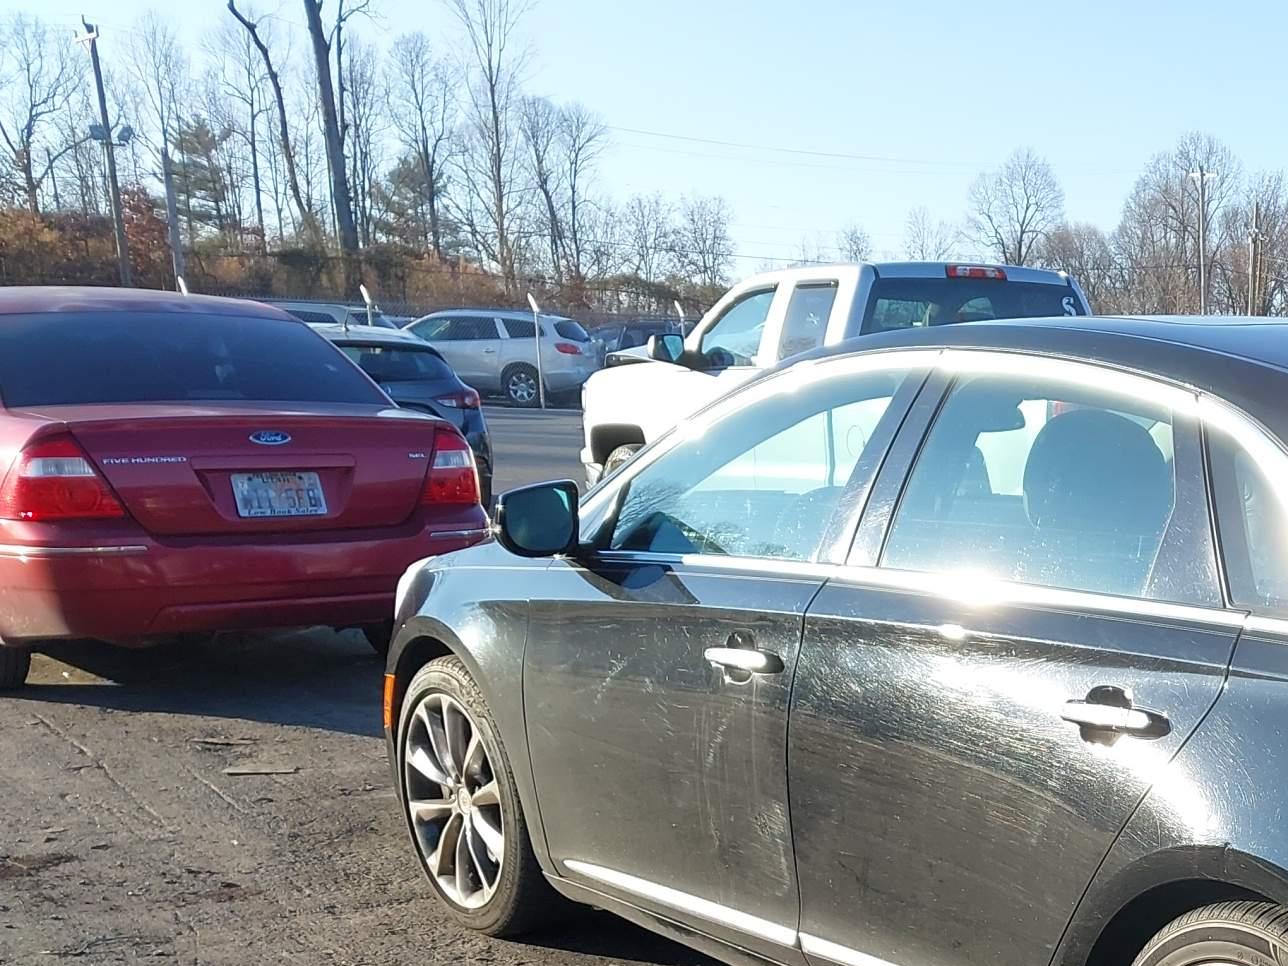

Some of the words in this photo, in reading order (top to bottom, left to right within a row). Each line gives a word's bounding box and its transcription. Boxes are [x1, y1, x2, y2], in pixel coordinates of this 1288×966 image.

[259, 430, 283, 442] Ford
[102, 457, 129, 465] FIVE
[131, 456, 187, 464] HUNDRED
